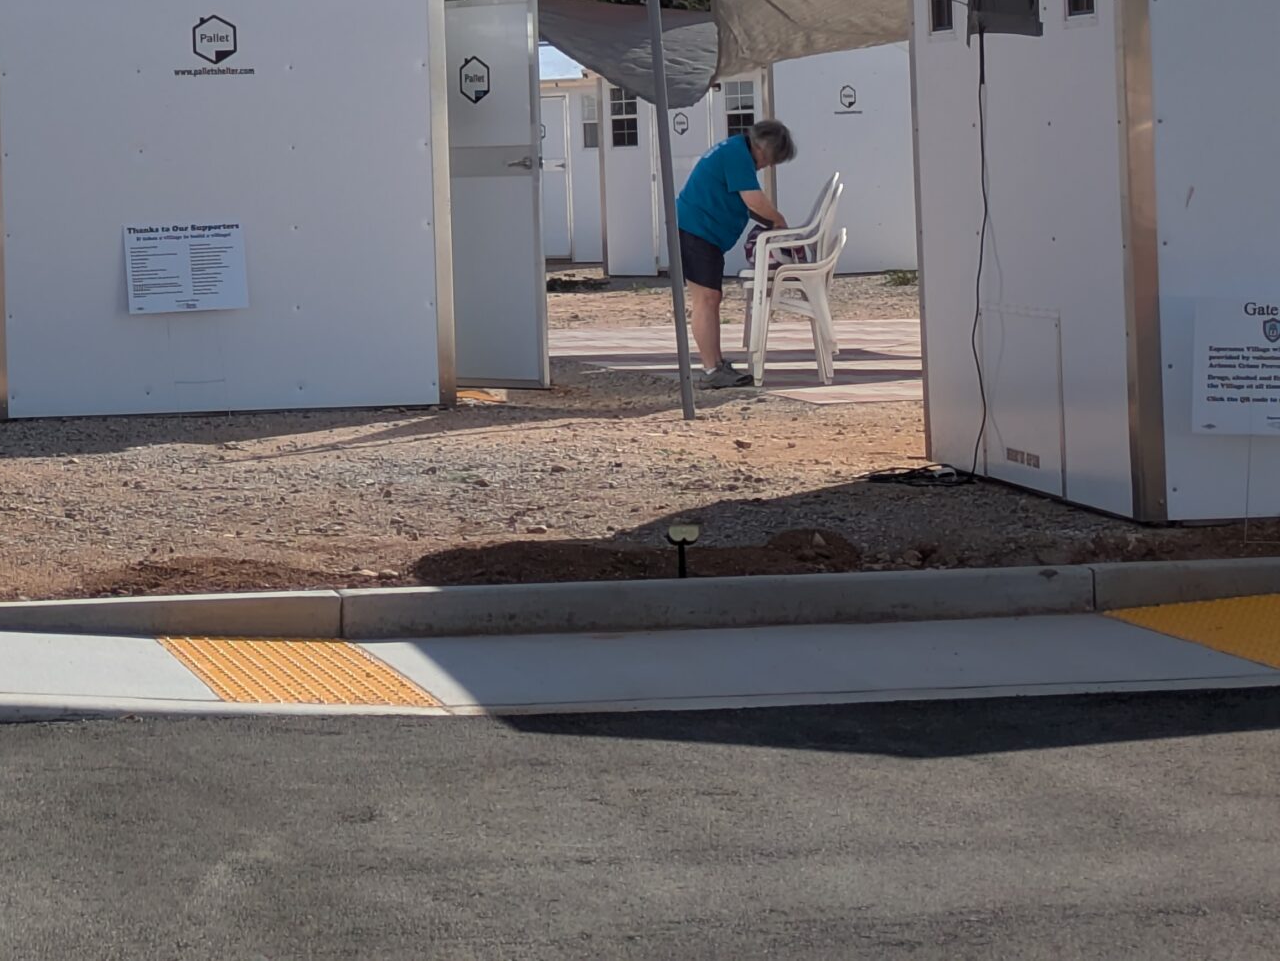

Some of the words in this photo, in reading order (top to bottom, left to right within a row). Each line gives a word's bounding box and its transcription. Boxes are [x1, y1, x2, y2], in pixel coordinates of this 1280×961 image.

[200, 33, 230, 44] Pallet
[174, 67, 255, 77] www.palletshelter.com
[464, 73, 485, 83] Pallet
[127, 226, 159, 235] Thanks
[172, 225, 189, 233] Our
[191, 223, 240, 232] Supporters
[1243, 301, 1279, 317] Gate
